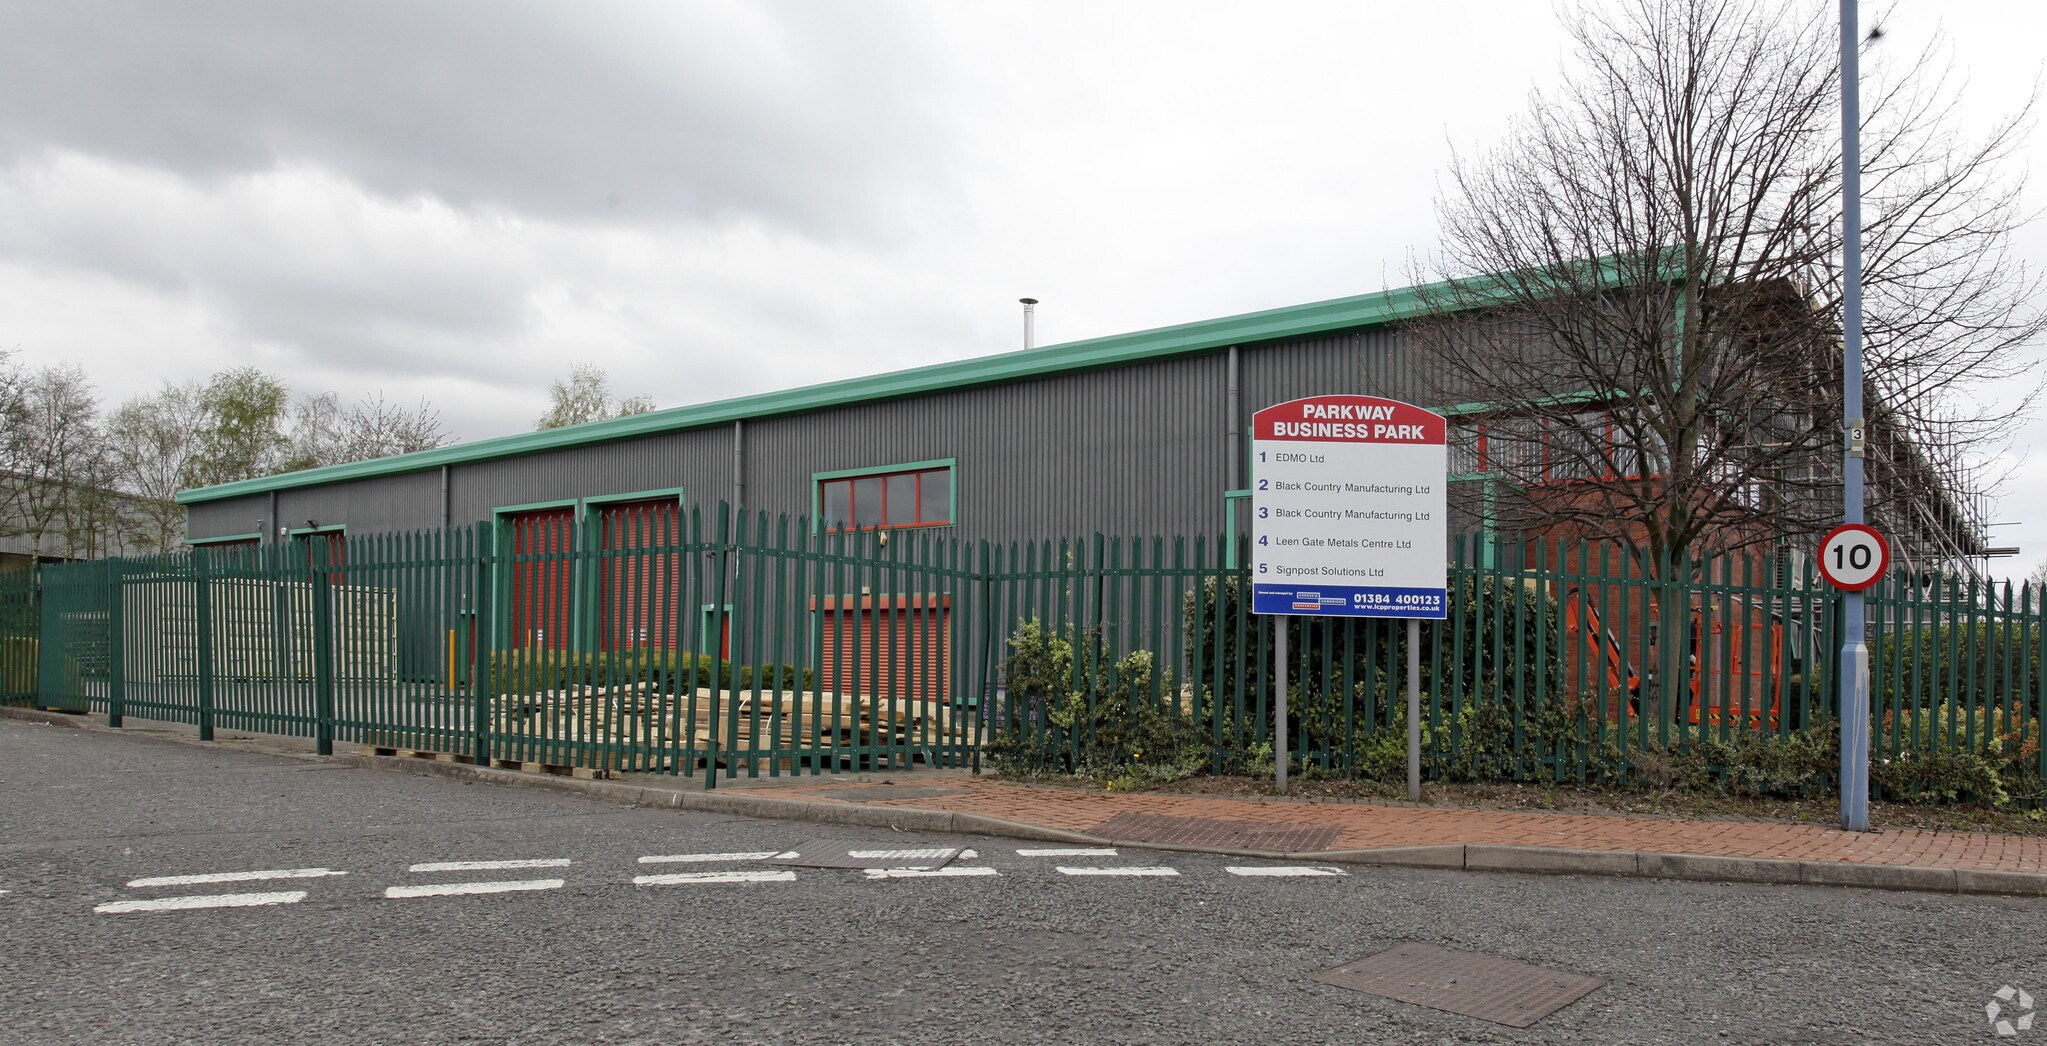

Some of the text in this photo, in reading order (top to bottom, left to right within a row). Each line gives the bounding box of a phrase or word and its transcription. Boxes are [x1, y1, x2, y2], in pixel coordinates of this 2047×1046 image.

[1303, 404, 1395, 421] PARKWAY
[1273, 421, 1425, 440] BUSINESS PARK
[1853, 429, 1862, 440] 3
[1259, 451, 1325, 464] 1 EDMO Ltd
[1258, 479, 1430, 496] 2 Black Country Manufacturing Ltd
[1258, 507, 1430, 523] 3 Black Country Manufacturing Ltd
[1258, 535, 1412, 549] 4 Leen Gate Metals Centre Ltd
[1833, 544, 1872, 570] 10
[1258, 563, 1384, 577] 5 Signpost Solutions Ltd
[1353, 594, 1391, 604] 01384
[1395, 595, 1441, 605] 400123
[1353, 604, 1441, 612] www.lcpproperties.co.uk
